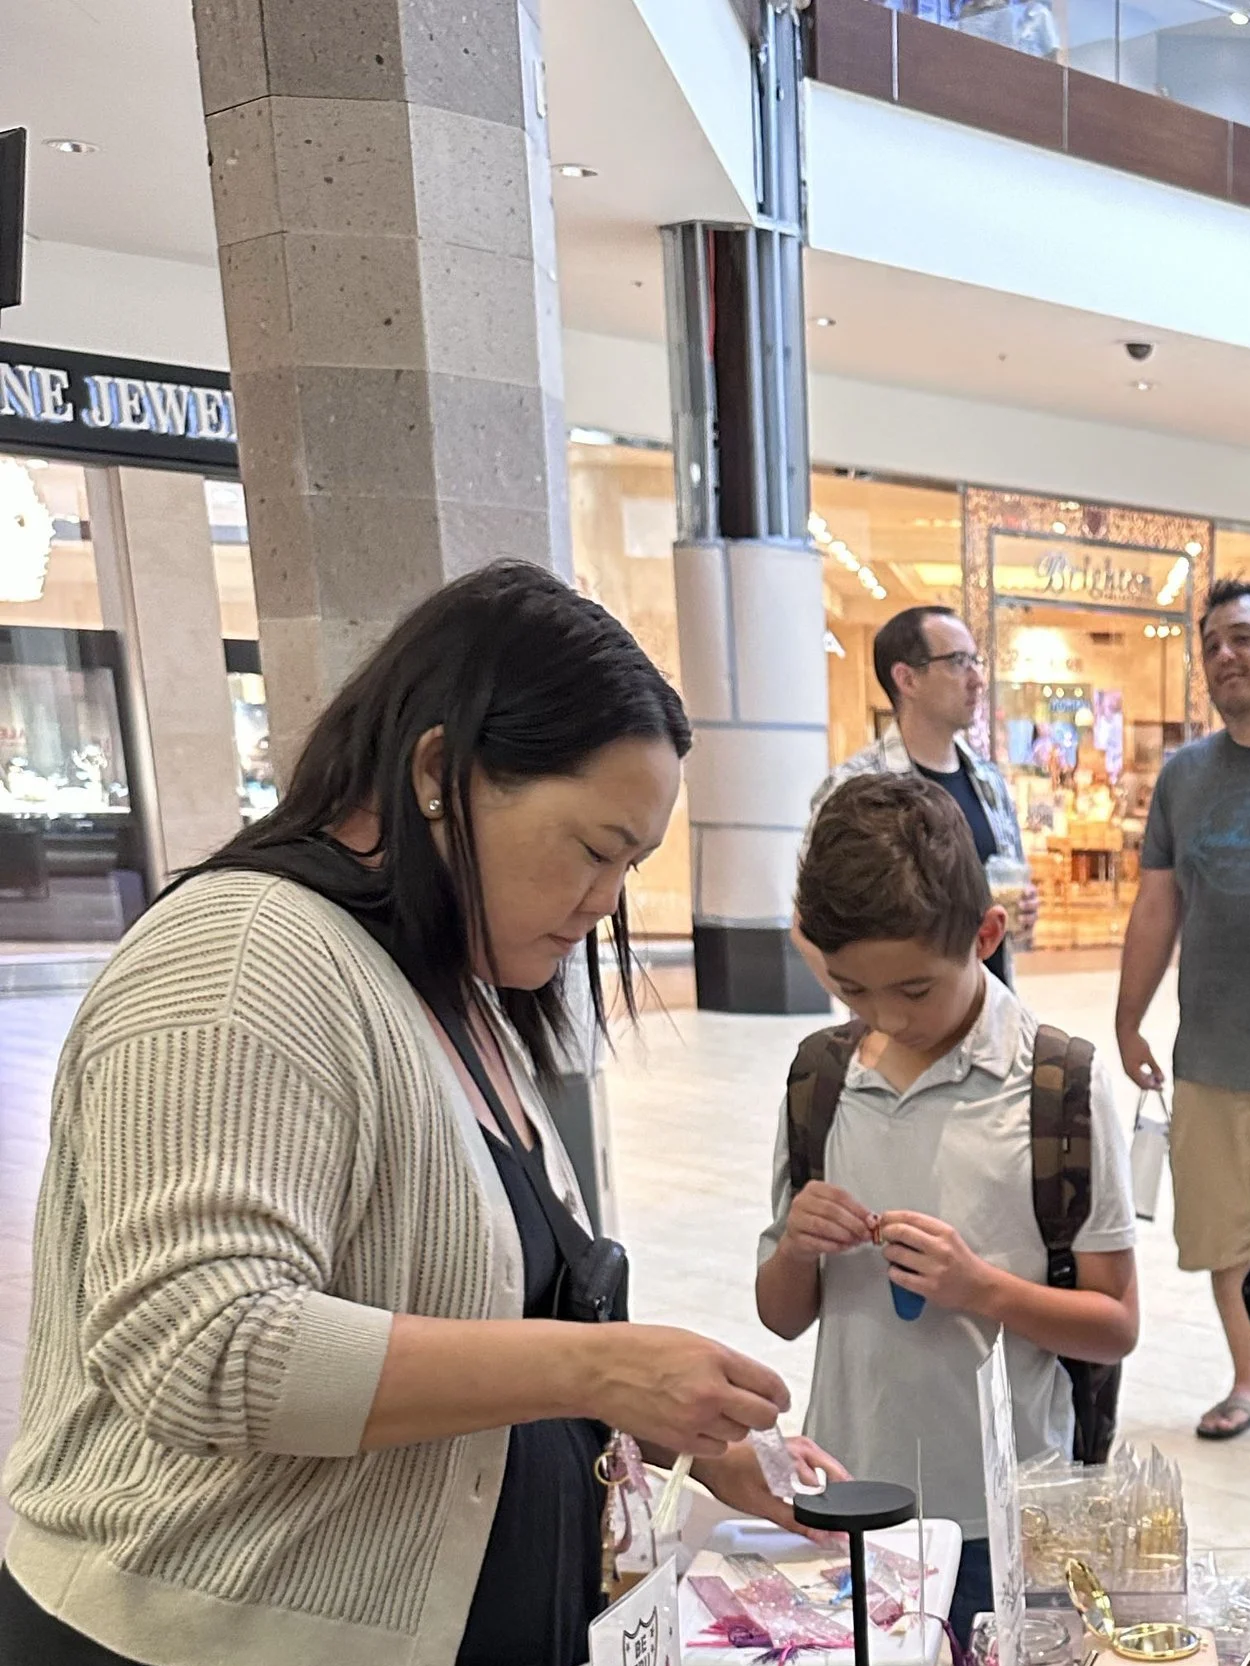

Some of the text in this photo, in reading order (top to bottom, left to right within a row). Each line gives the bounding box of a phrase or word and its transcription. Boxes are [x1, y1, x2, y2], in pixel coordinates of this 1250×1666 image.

[0, 361, 238, 443] NE JEWE
[634, 1633, 647, 1659] BE
